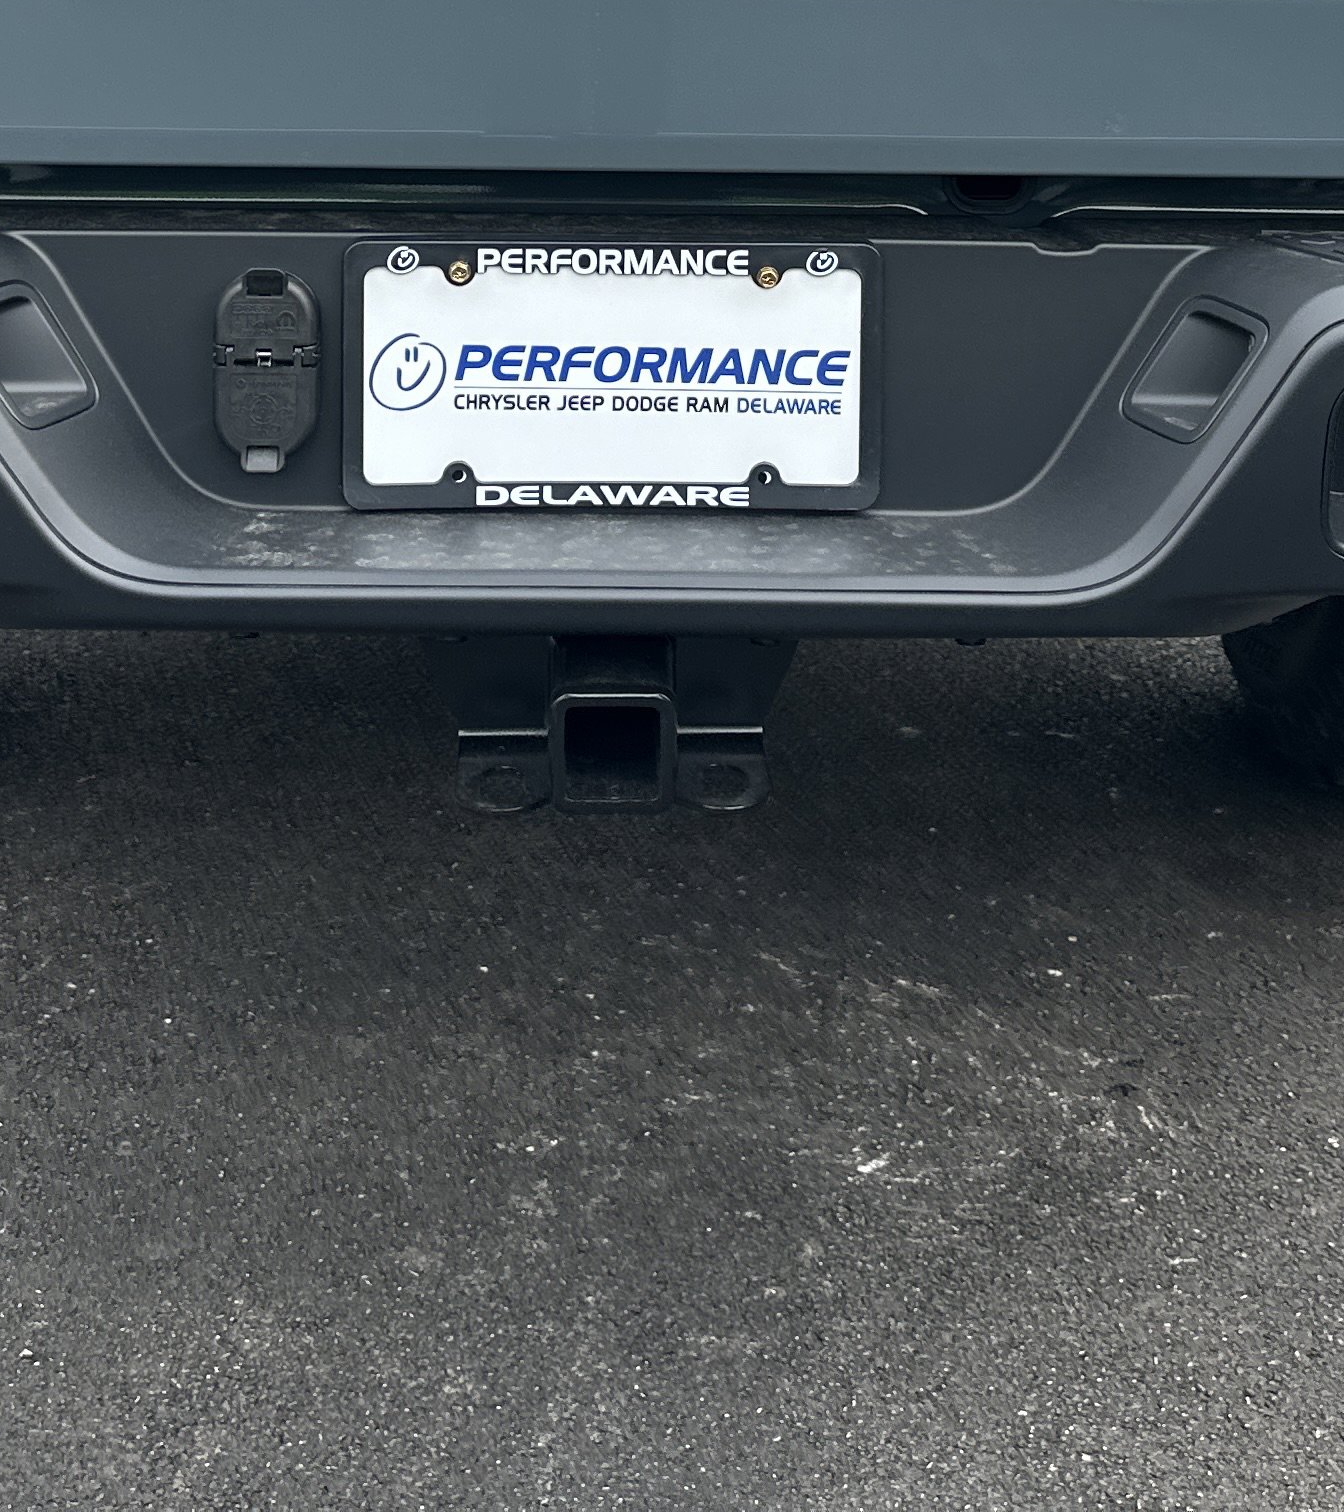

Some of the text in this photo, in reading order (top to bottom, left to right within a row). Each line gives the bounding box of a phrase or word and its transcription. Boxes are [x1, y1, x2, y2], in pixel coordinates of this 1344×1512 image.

[476, 248, 749, 277] PERFORMANCE
[455, 344, 852, 386] PERFORMANCE
[454, 393, 842, 415] CHRYSLER JEEP DODGE RAM DELAWARE
[475, 485, 750, 507] DELAWARE
